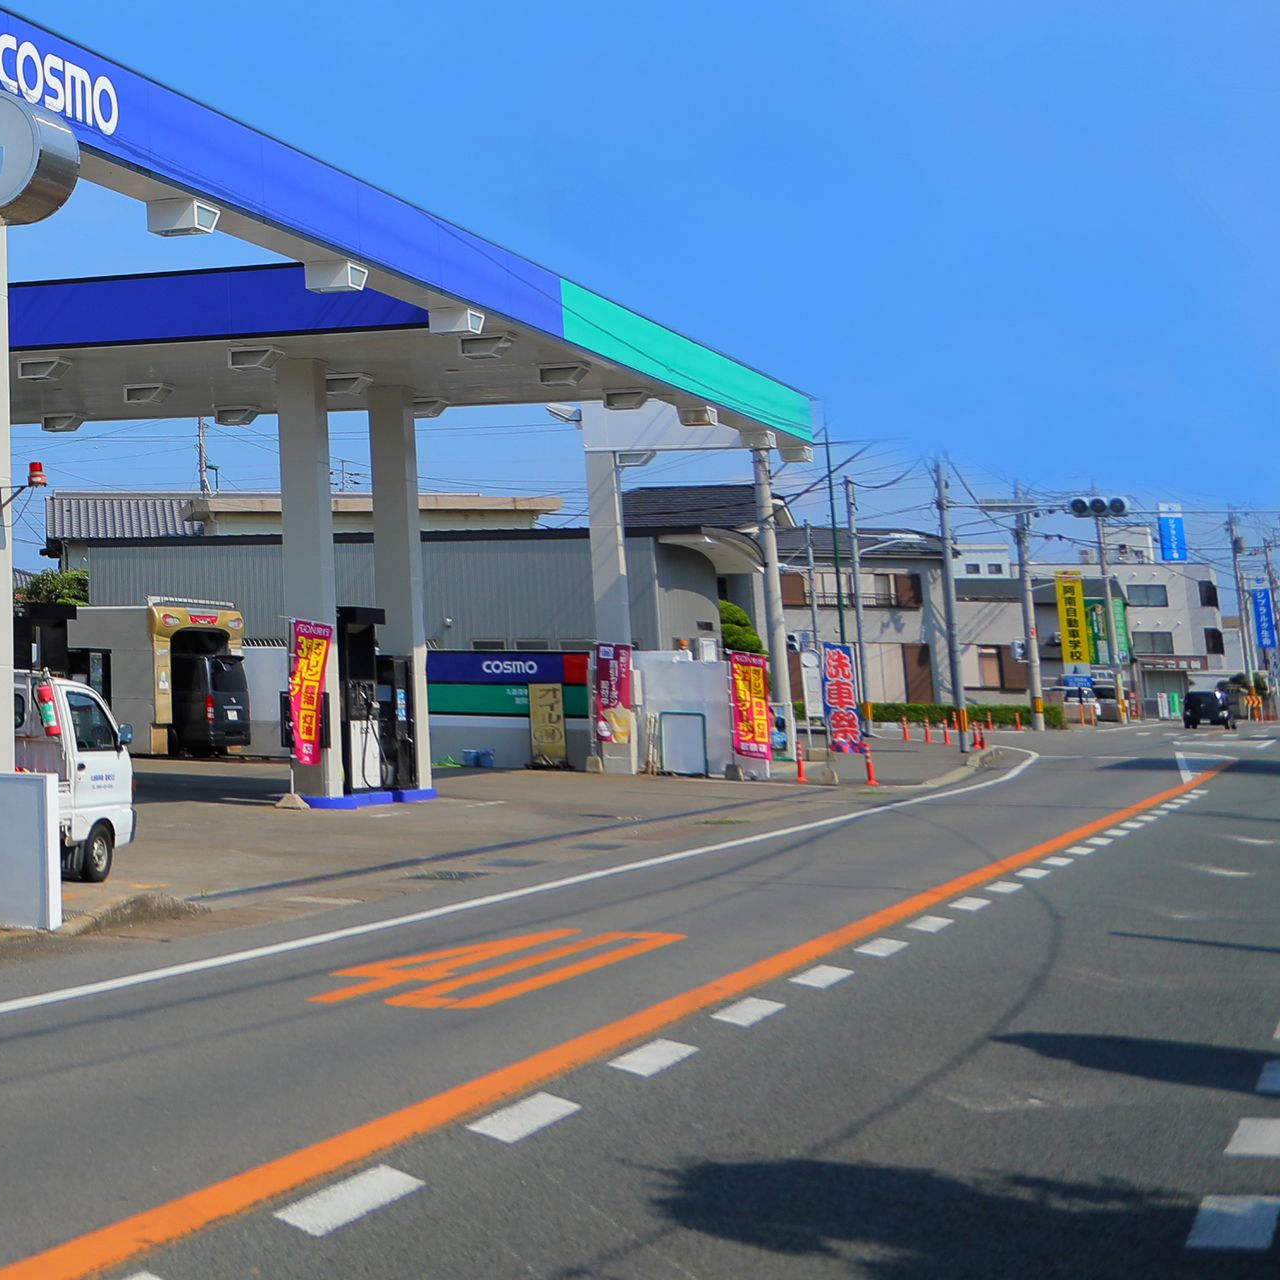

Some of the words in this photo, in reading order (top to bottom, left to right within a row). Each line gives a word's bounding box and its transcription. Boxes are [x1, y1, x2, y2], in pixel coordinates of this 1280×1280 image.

[1062, 585, 1083, 661] 阿南自動車学校
[482, 660, 538, 674] COSMO
[824, 647, 862, 744] 洗車祭
[305, 927, 689, 1010] 40
